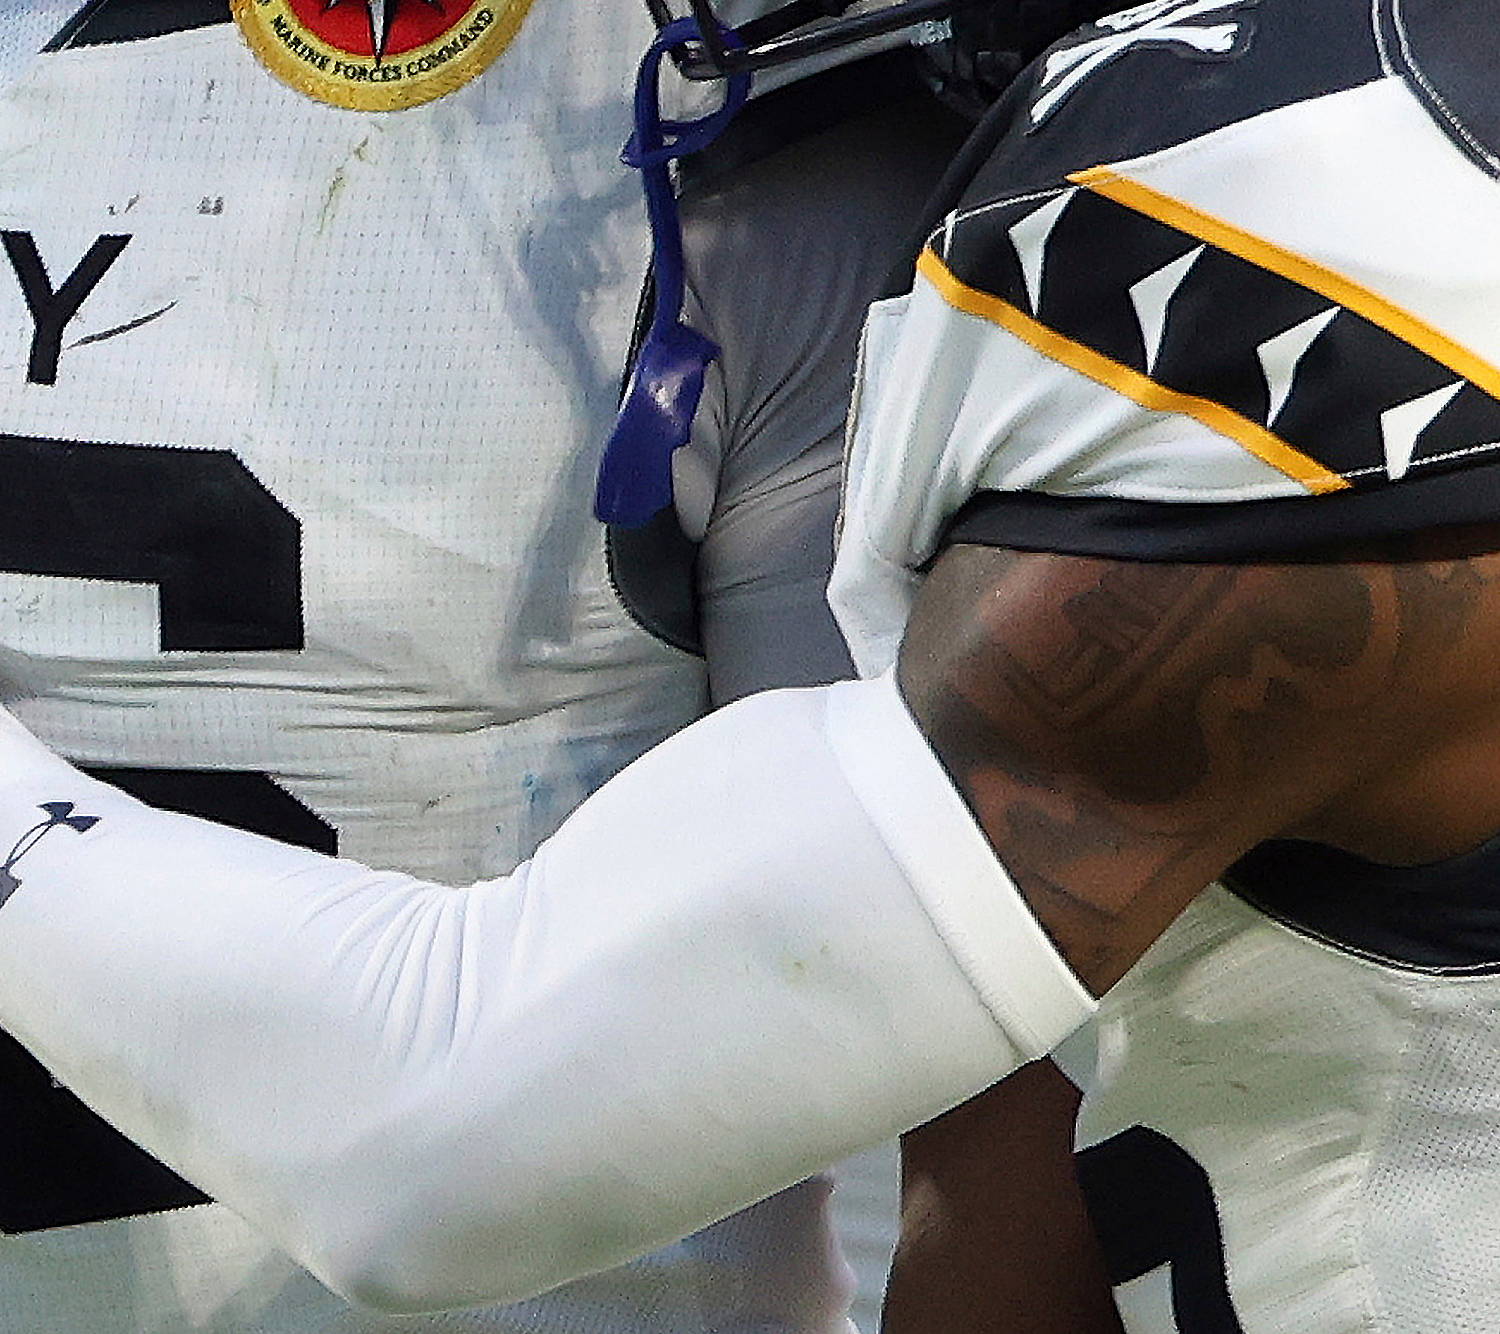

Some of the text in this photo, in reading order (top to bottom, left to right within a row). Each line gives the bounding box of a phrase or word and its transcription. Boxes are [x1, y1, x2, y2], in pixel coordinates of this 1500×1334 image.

[269, 8, 496, 84] MARINE FORCES COMMAND
